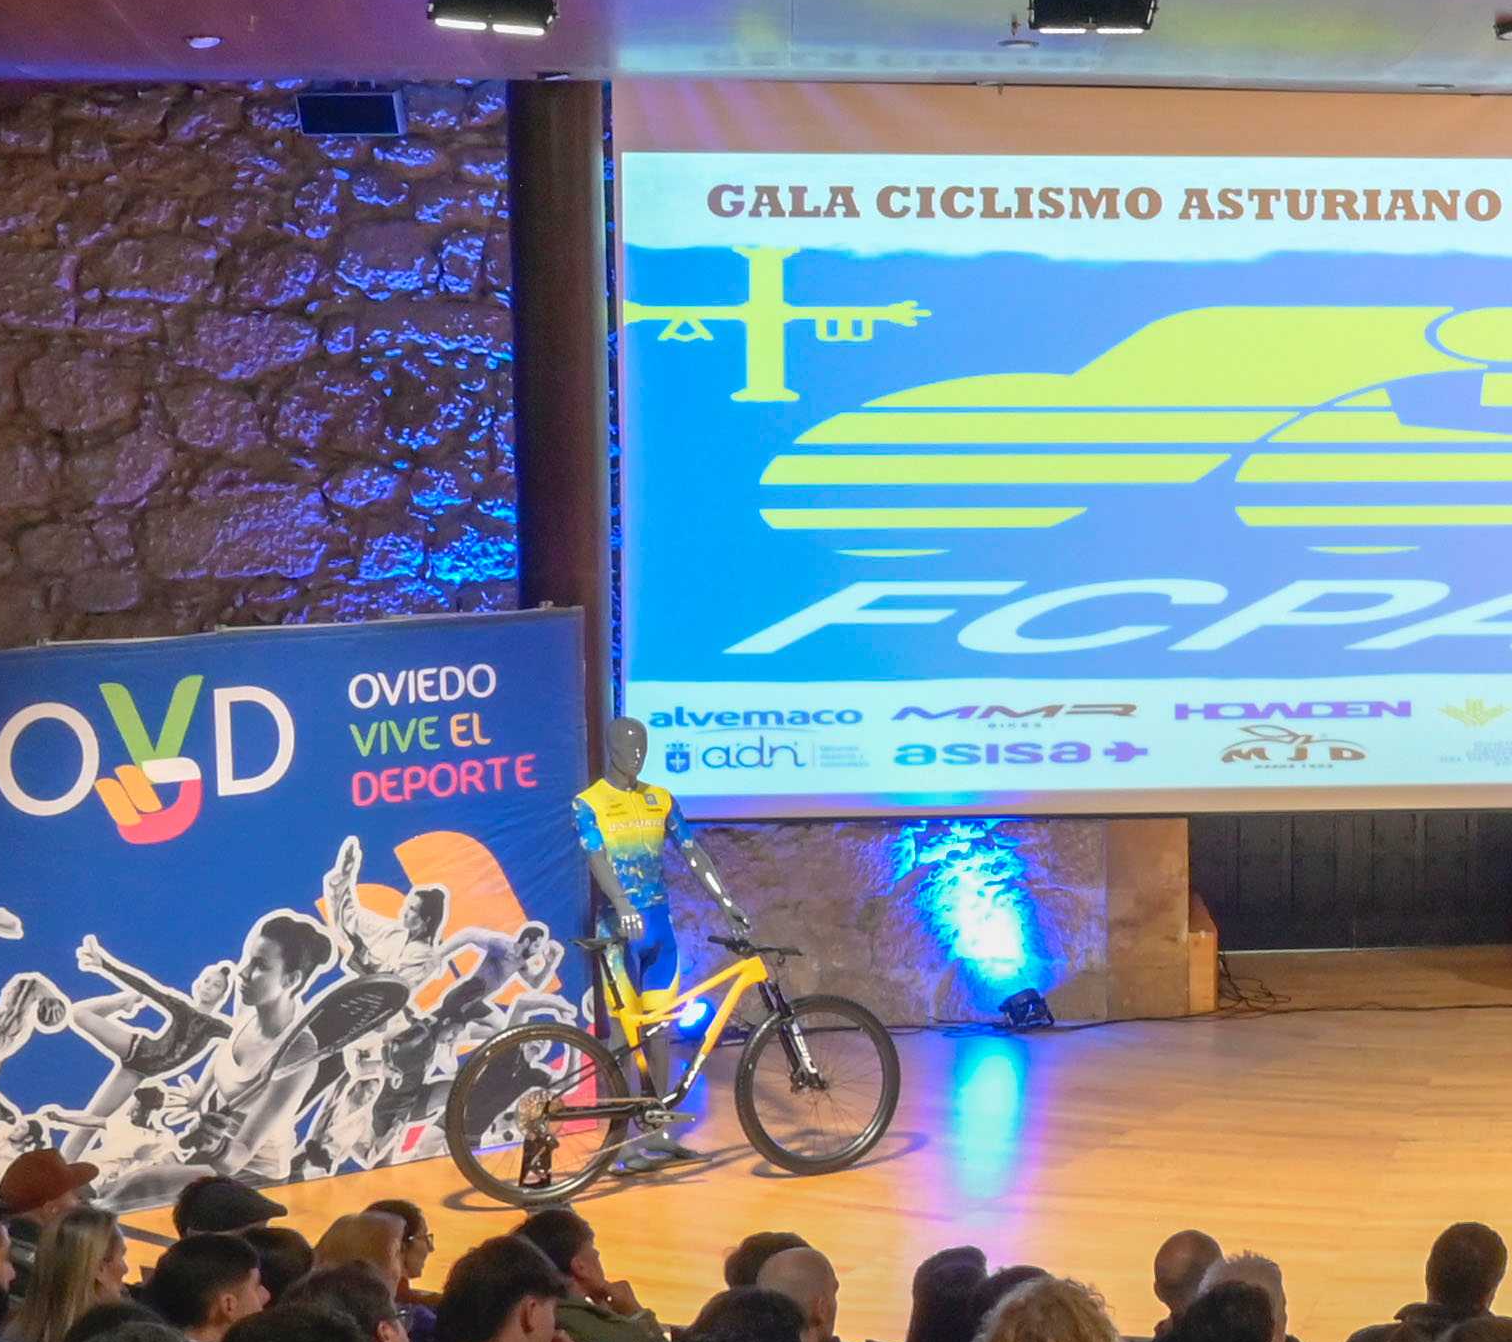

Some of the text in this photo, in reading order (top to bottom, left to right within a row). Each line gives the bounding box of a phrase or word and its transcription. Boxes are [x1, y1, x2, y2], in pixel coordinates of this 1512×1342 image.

[706, 184, 860, 219] GALA
[876, 185, 1163, 220] CICLISMO
[1178, 187, 1502, 222] ASTURIANO
[348, 663, 497, 709] OVIEDO
[648, 706, 863, 728] alvemaco
[1174, 701, 1412, 721] HOWDEN
[349, 712, 492, 757] VIVE EL
[351, 753, 537, 807] DEPORTE
